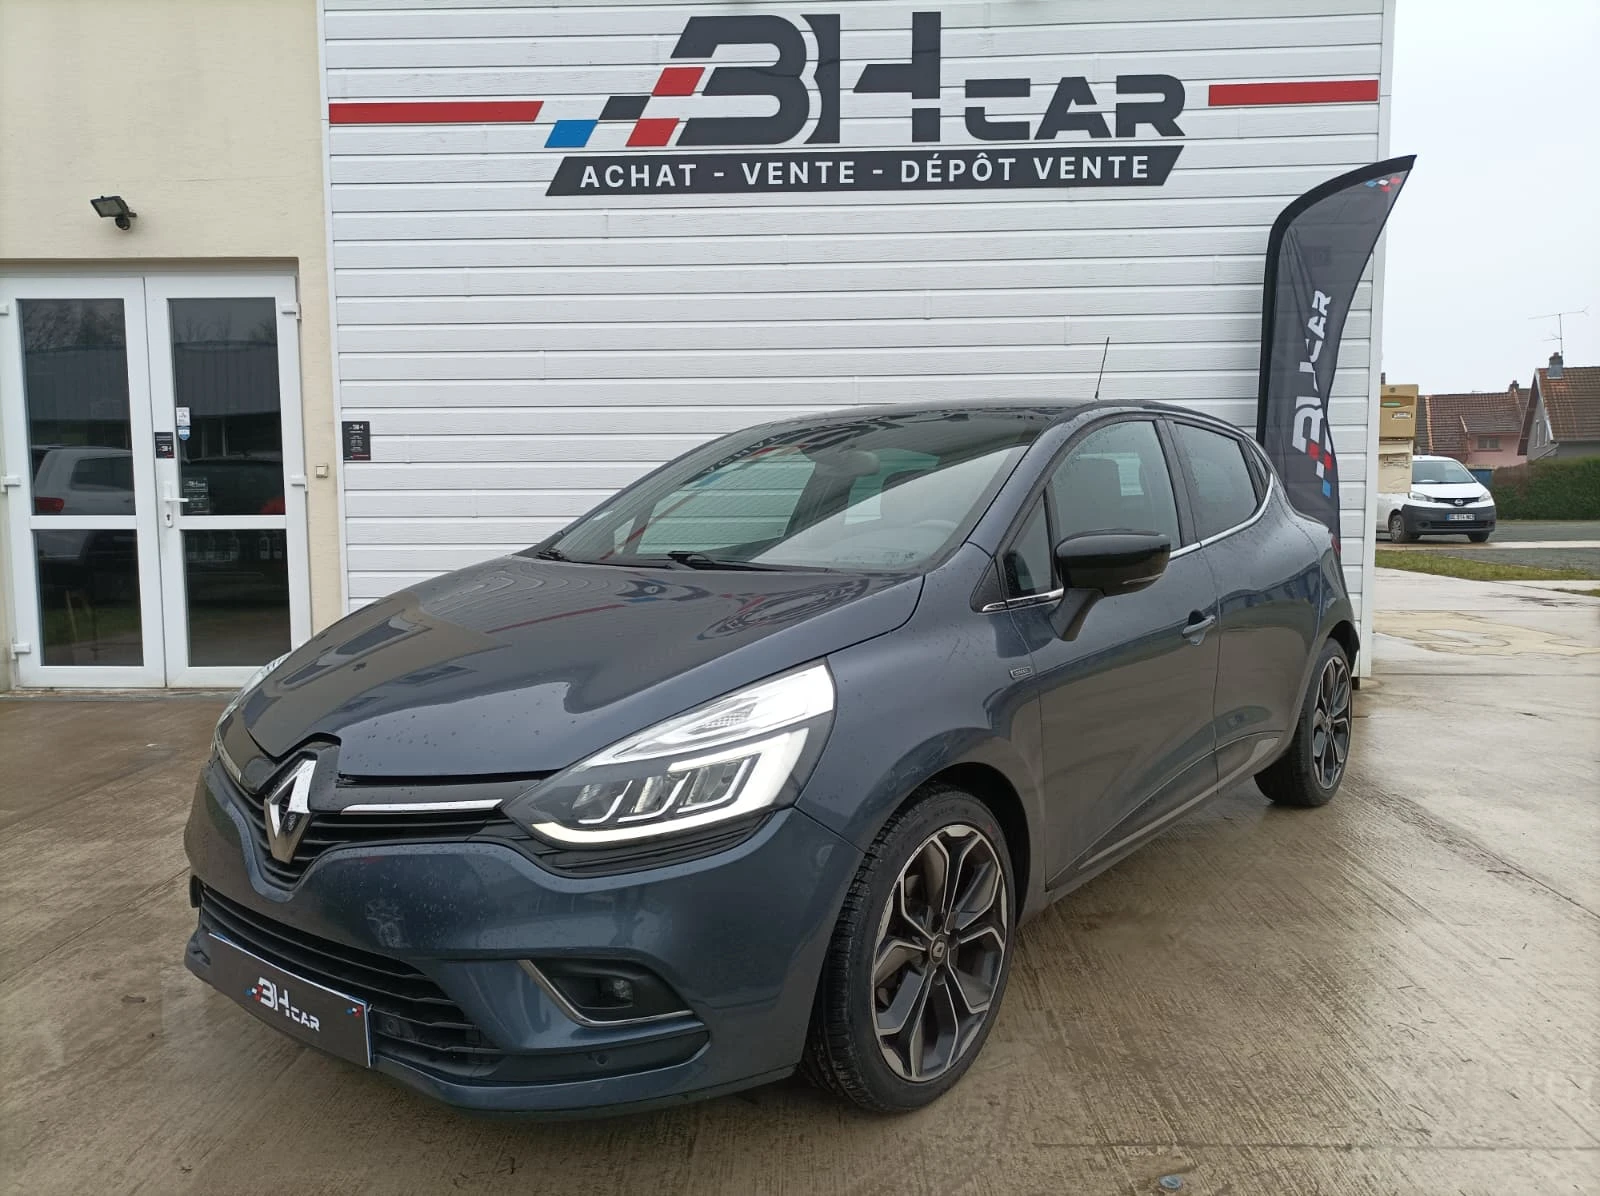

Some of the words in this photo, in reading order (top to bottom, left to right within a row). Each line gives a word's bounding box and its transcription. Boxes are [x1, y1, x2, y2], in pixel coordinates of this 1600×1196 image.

[580, 163, 697, 188] ACHAT
[741, 161, 855, 186] VENTE
[900, 152, 1016, 183] DÉPÔT
[1032, 155, 1149, 180] VENTE
